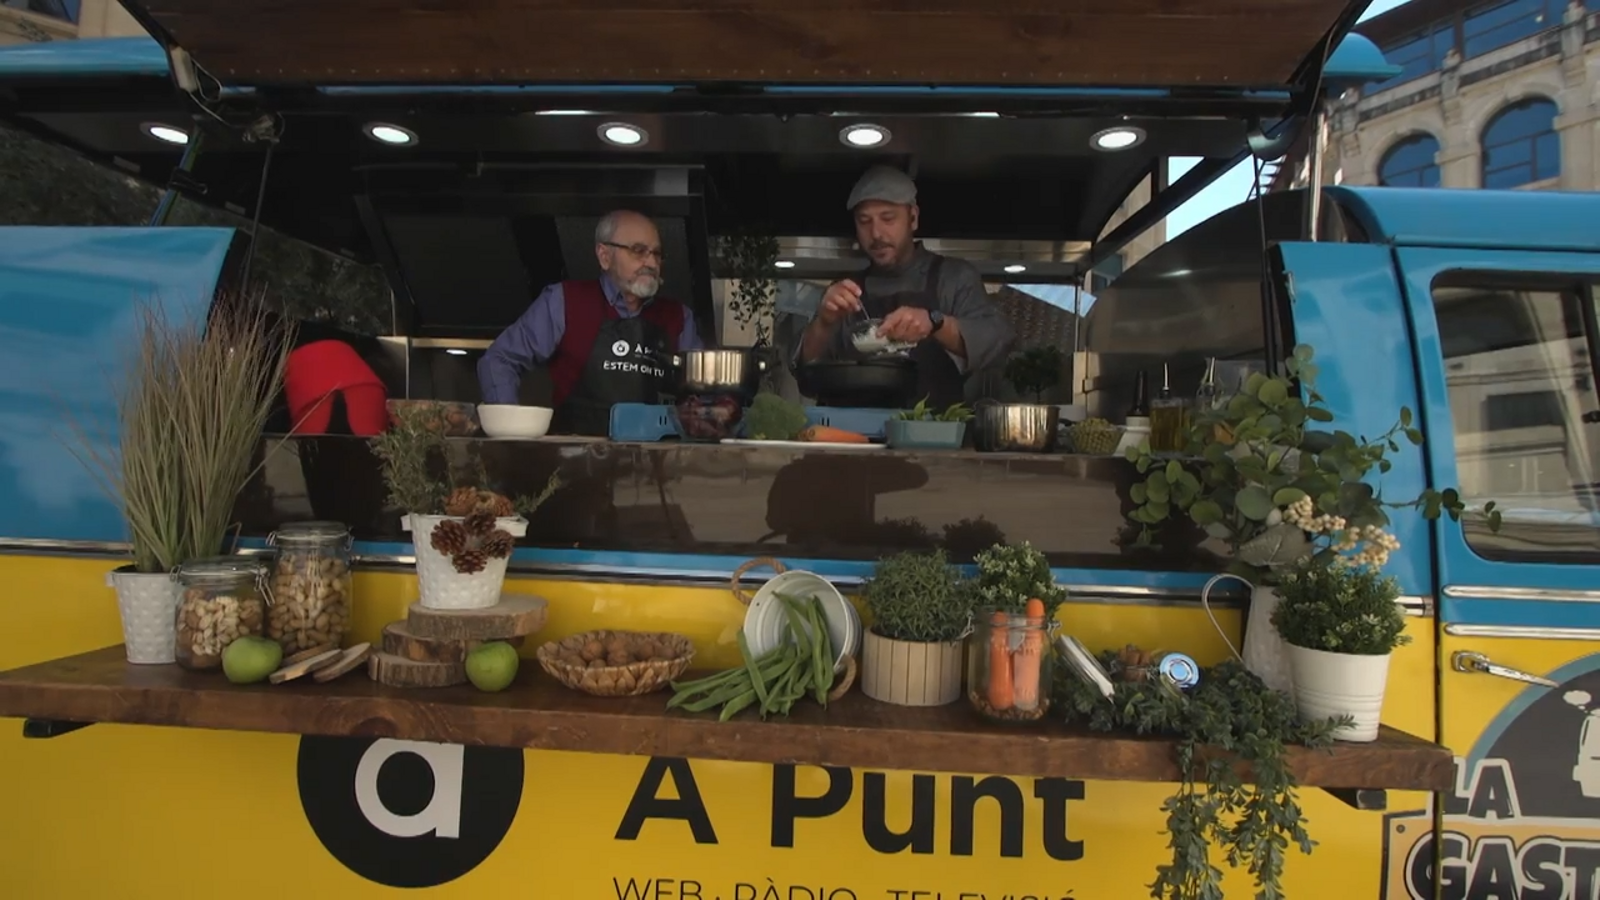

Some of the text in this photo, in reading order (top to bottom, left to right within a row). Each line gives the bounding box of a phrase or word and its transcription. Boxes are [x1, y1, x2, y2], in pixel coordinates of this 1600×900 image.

[603, 359, 638, 372] ESTEM
[771, 763, 1085, 861] Punt
[1427, 757, 1521, 821] LA
[612, 877, 702, 900] WEB
[1404, 830, 1600, 900] GAST
